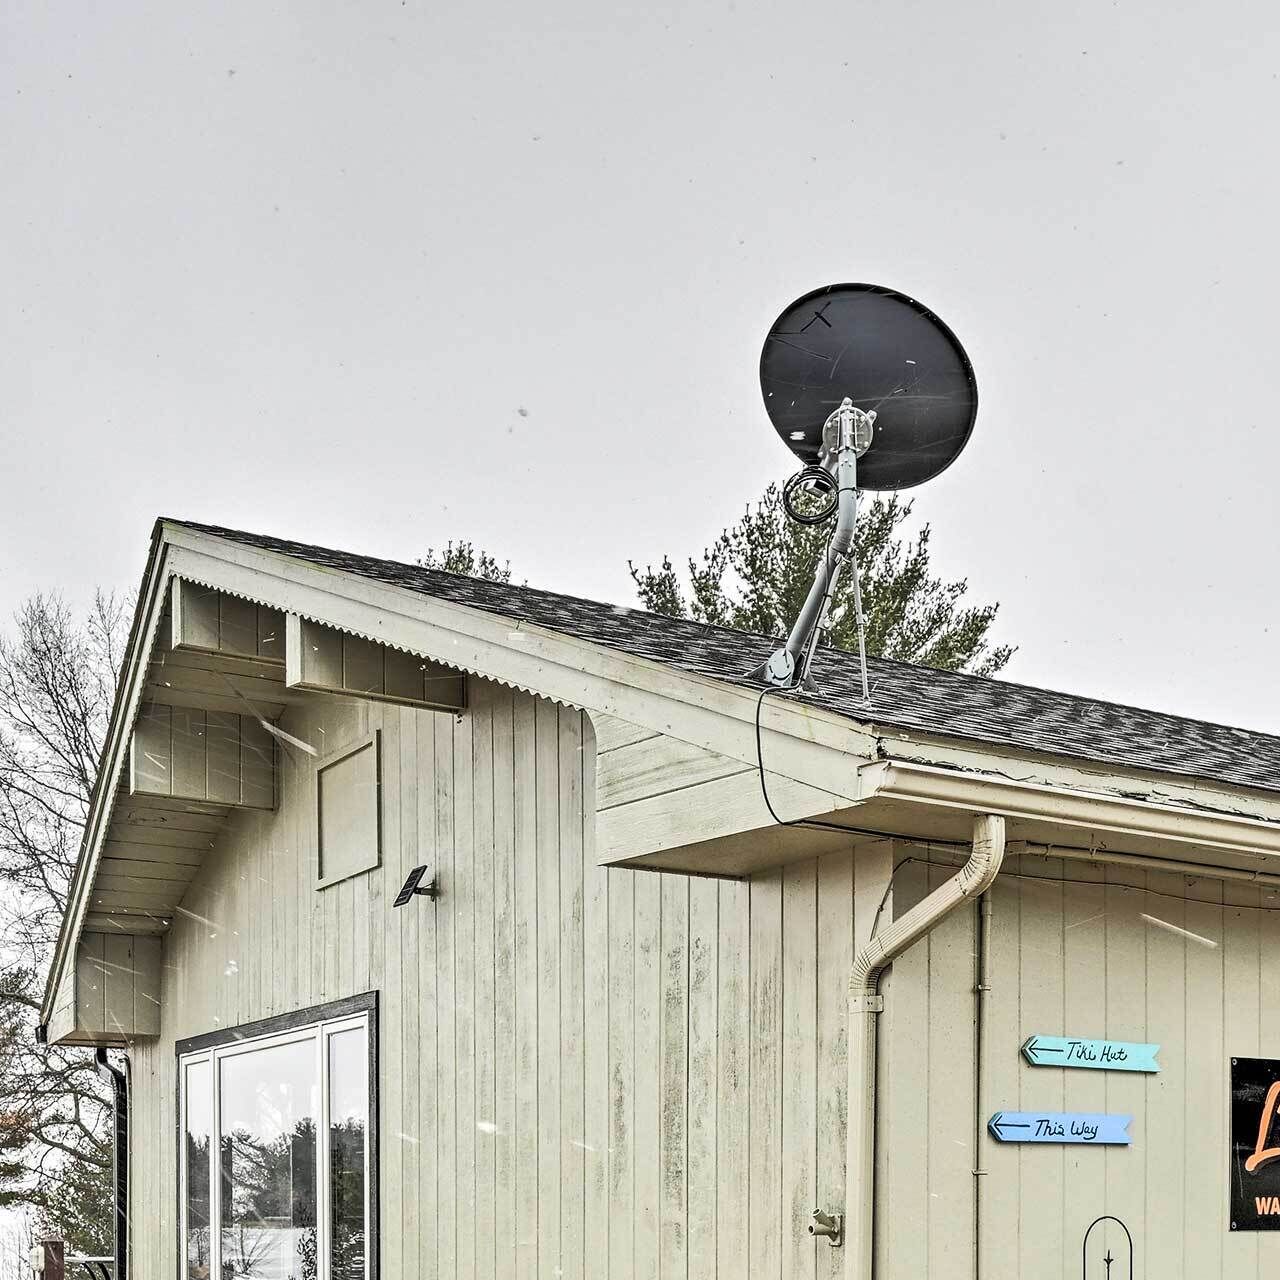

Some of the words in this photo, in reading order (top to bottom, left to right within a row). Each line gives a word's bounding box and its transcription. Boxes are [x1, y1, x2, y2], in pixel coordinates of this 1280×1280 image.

[1067, 1042, 1096, 1060] Tiki
[1100, 1046, 1127, 1062] Hut
[1035, 1119, 1065, 1136] This
[1070, 1121, 1098, 1140] Way
